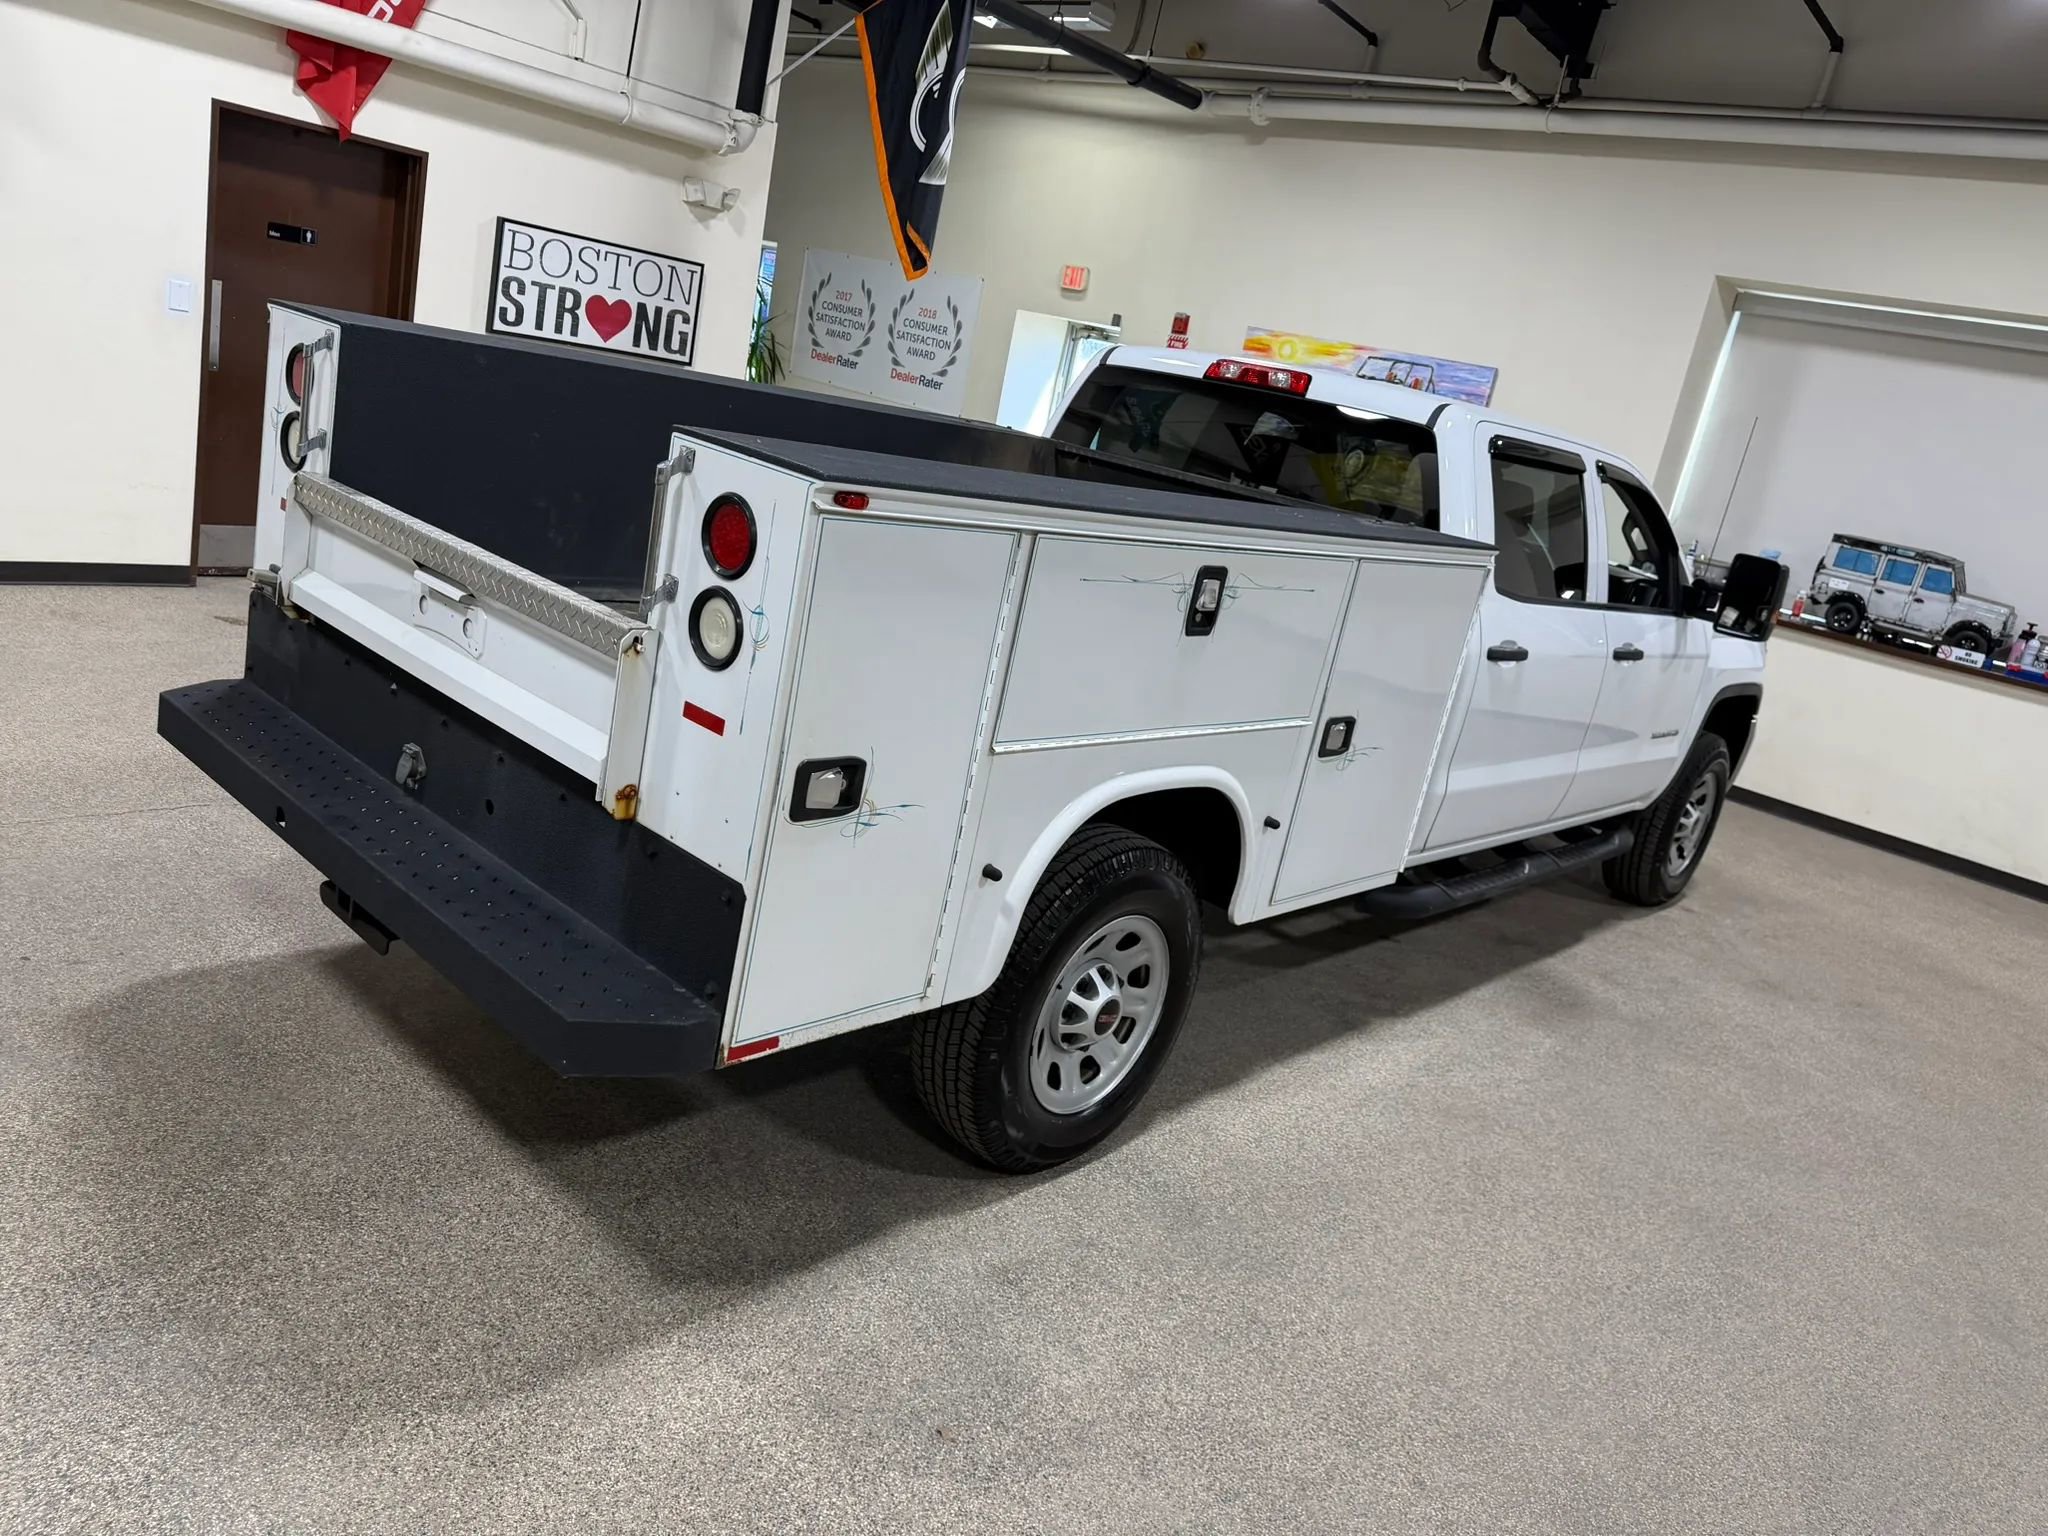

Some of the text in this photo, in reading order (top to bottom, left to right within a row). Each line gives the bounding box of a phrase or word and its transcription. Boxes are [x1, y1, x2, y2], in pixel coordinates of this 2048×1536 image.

[503, 228, 698, 305] BOSTON
[1063, 266, 1085, 289] EXIT
[835, 290, 853, 302] 2017
[821, 300, 863, 317] CONSUMER
[918, 307, 937, 320] 2018
[815, 312, 866, 332] SATISFACTION
[903, 317, 948, 336] CONSUMER
[825, 328, 852, 342] AWARD
[896, 330, 951, 350] SATISFACTION
[810, 348, 859, 370] DealerRater
[906, 346, 936, 361] AWARD
[890, 367, 943, 391] DealerRater
